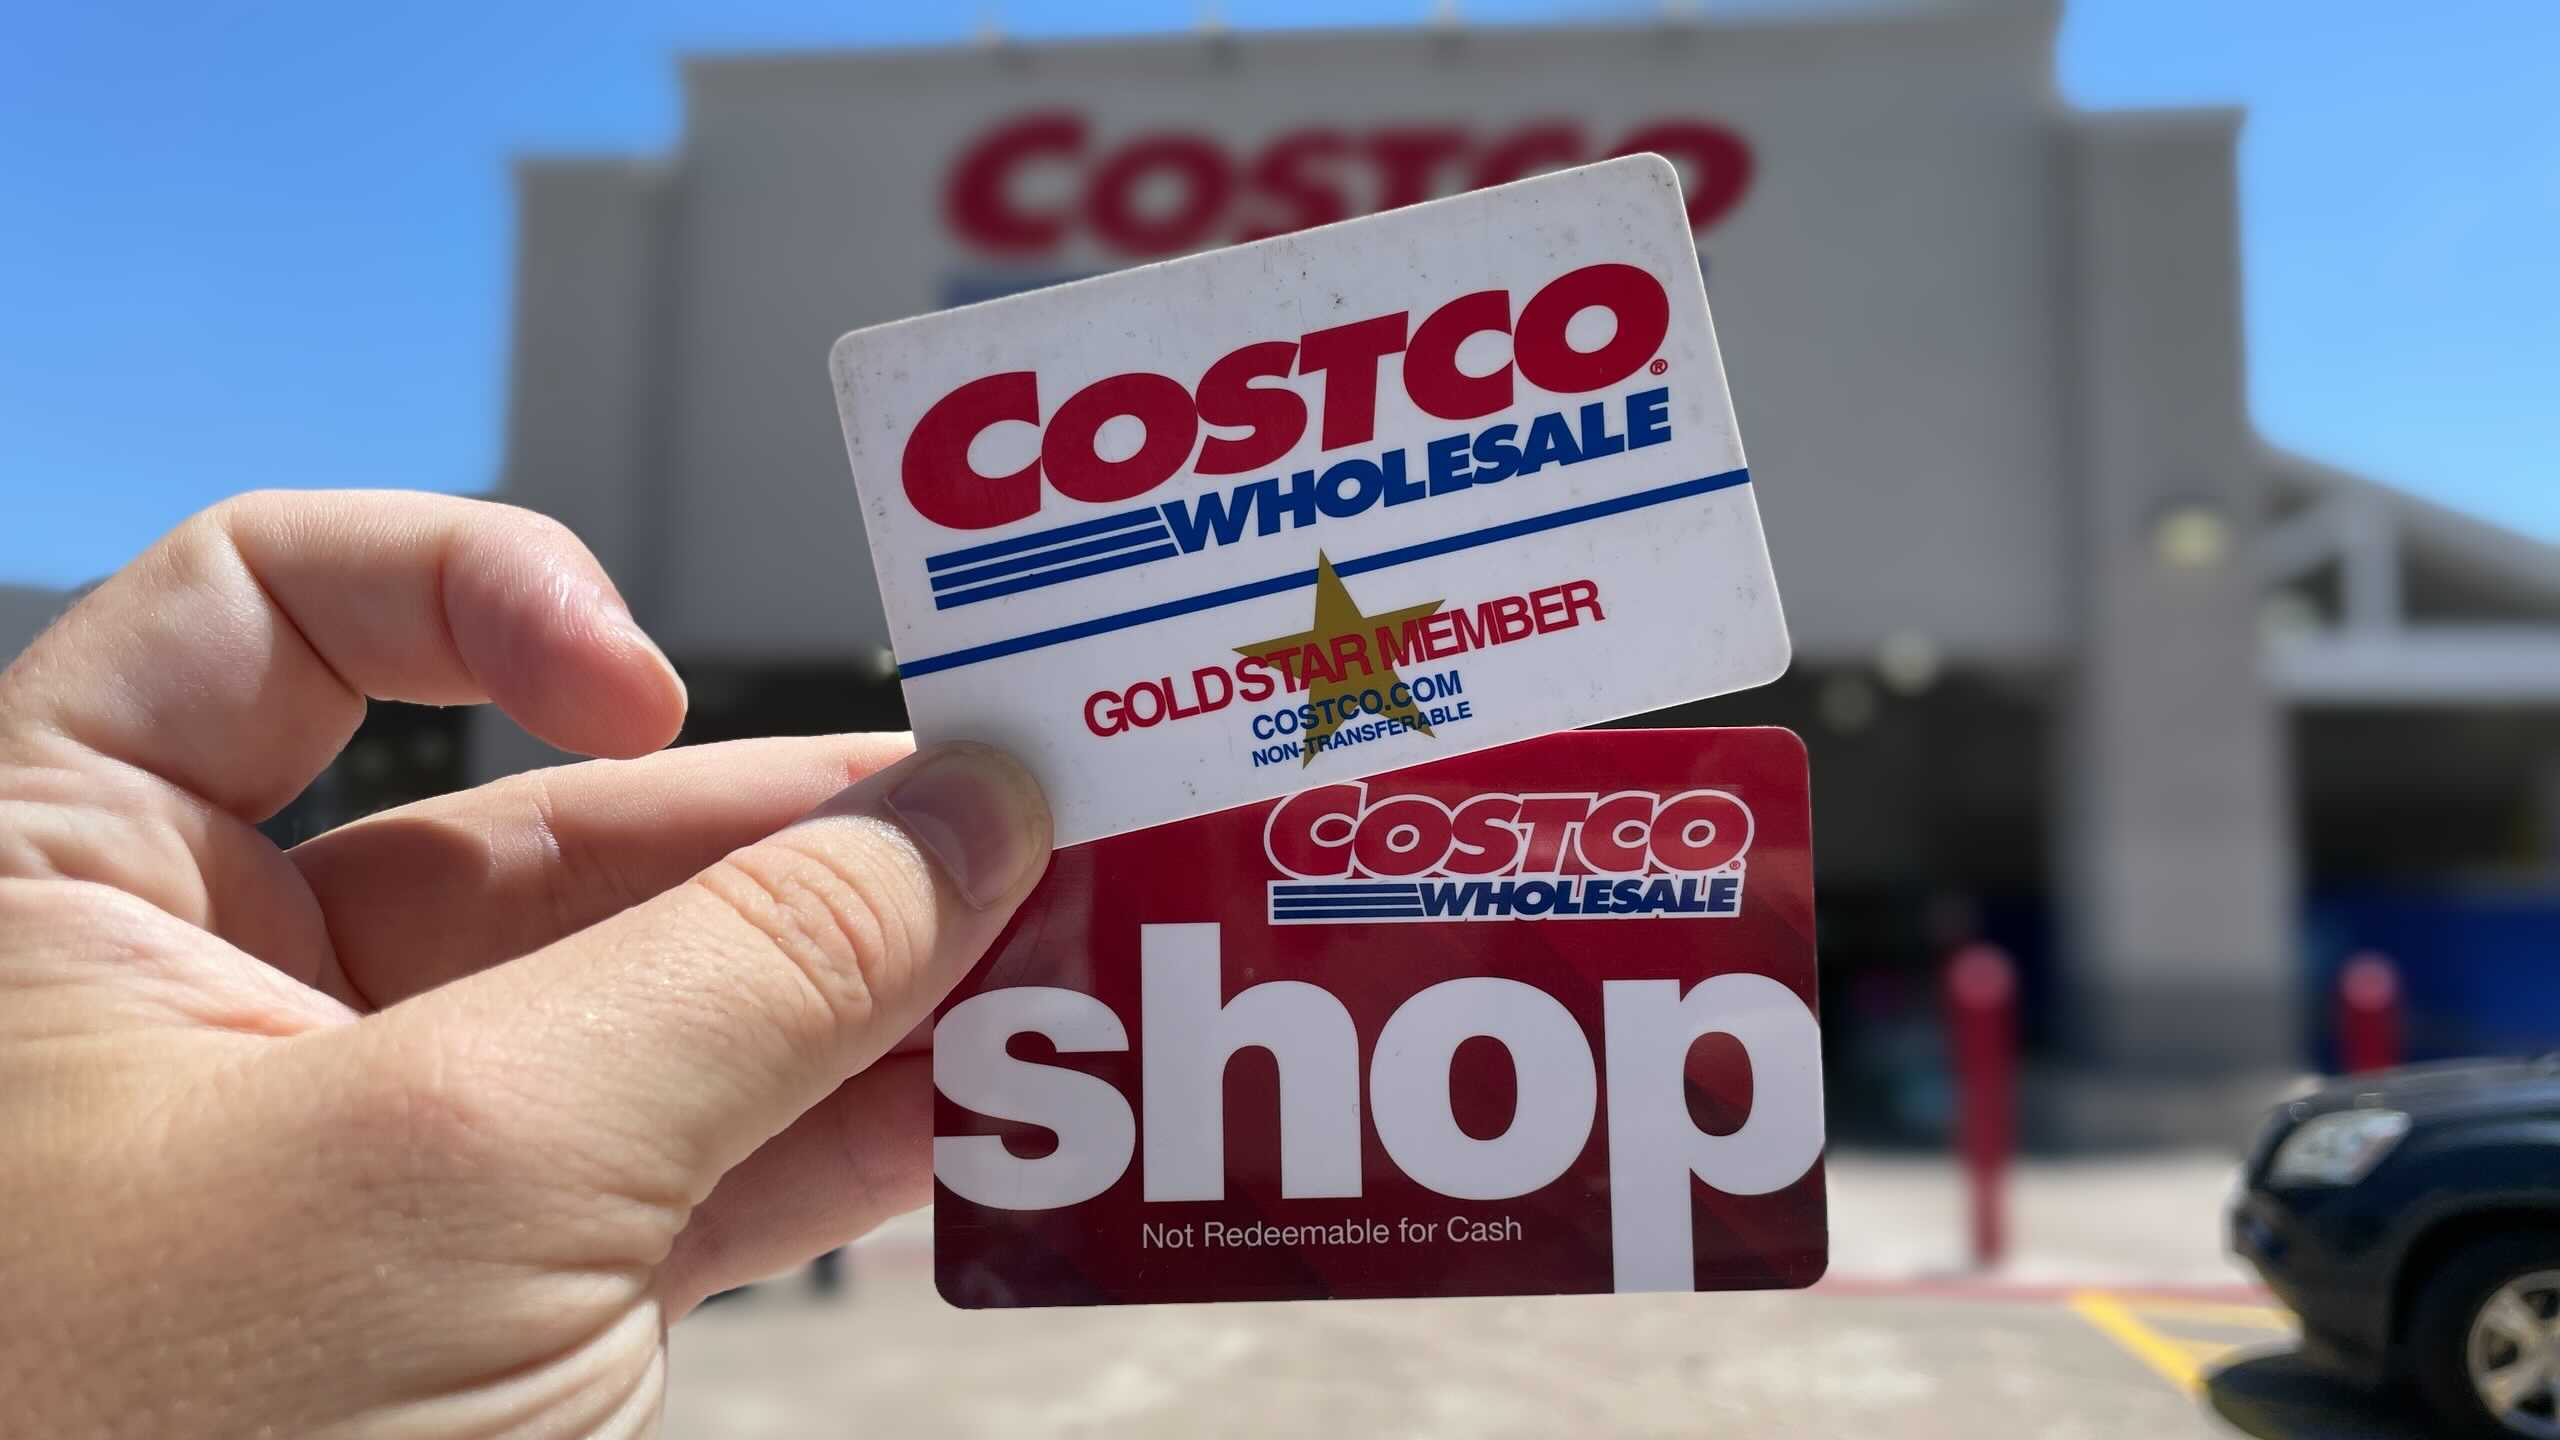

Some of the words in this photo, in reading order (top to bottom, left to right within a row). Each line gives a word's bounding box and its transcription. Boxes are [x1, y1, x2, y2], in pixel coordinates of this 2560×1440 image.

[902, 263, 1669, 531] COSTCO
[1158, 387, 1671, 553] WHOLESALE
[1084, 666, 1234, 738] GOLD
[1235, 634, 1373, 702] STAR
[1377, 579, 1605, 671] MEMBER
[1252, 670, 1463, 740] COSTCO.COM
[1252, 701, 1473, 768] NON-TRANSFERABLE
[1264, 780, 1755, 881] COSTCO
[1418, 877, 1739, 917] WHOLESALE
[934, 922, 1826, 1294] shop
[1143, 1223, 1194, 1248] Not
[1204, 1218, 1389, 1247] Redeemable
[1398, 1218, 1437, 1243] for
[1446, 1216, 1522, 1242] Cash
